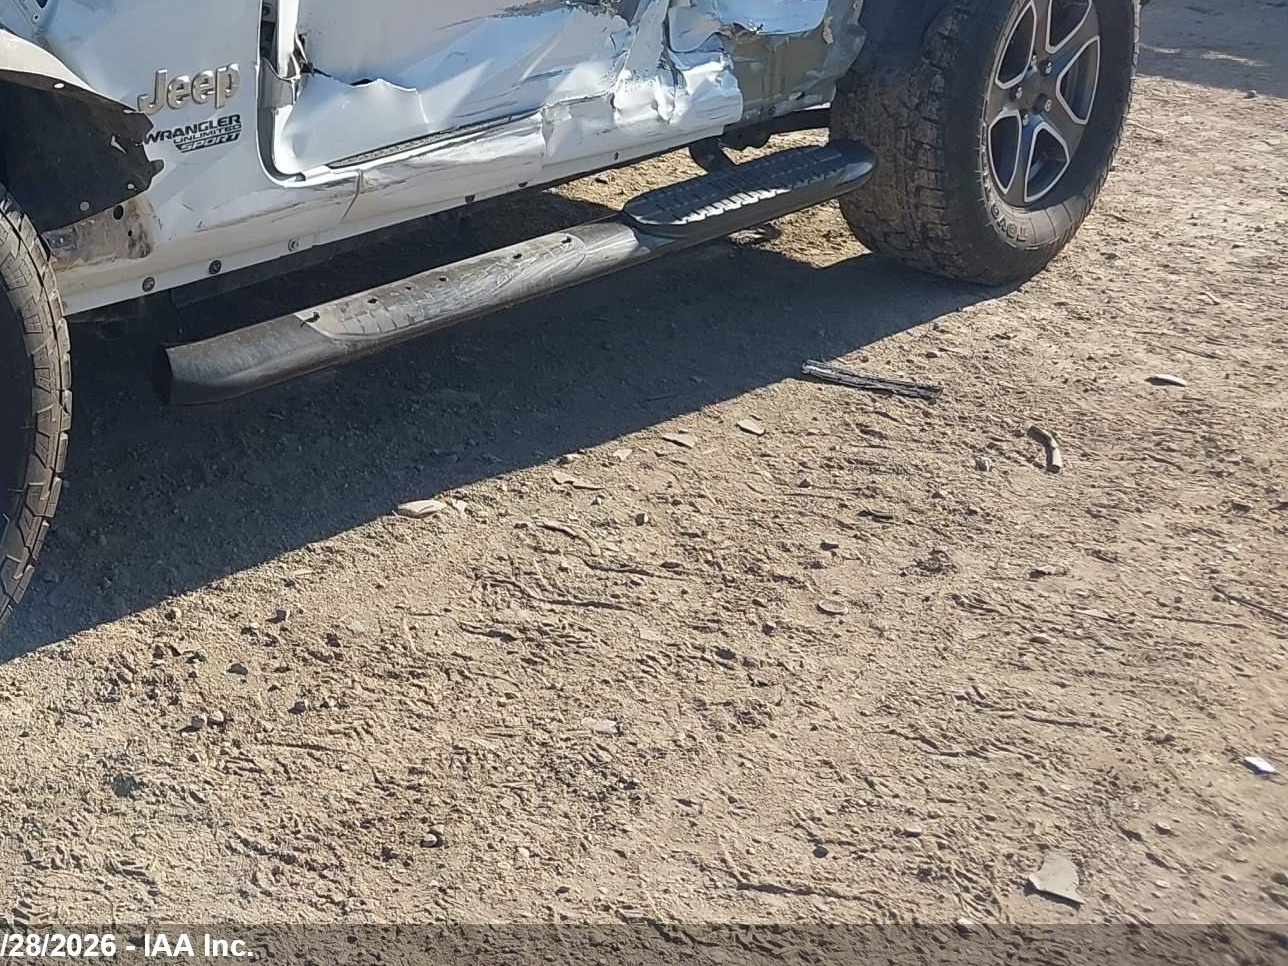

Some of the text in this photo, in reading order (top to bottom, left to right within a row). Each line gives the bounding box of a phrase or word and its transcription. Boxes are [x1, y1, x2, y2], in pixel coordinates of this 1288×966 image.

[137, 63, 241, 116] Jeep
[144, 114, 242, 145] WRANGLER
[173, 123, 242, 145] UNLIMITED
[178, 132, 241, 153] SPORT
[990, 202, 1031, 243] TOYO
